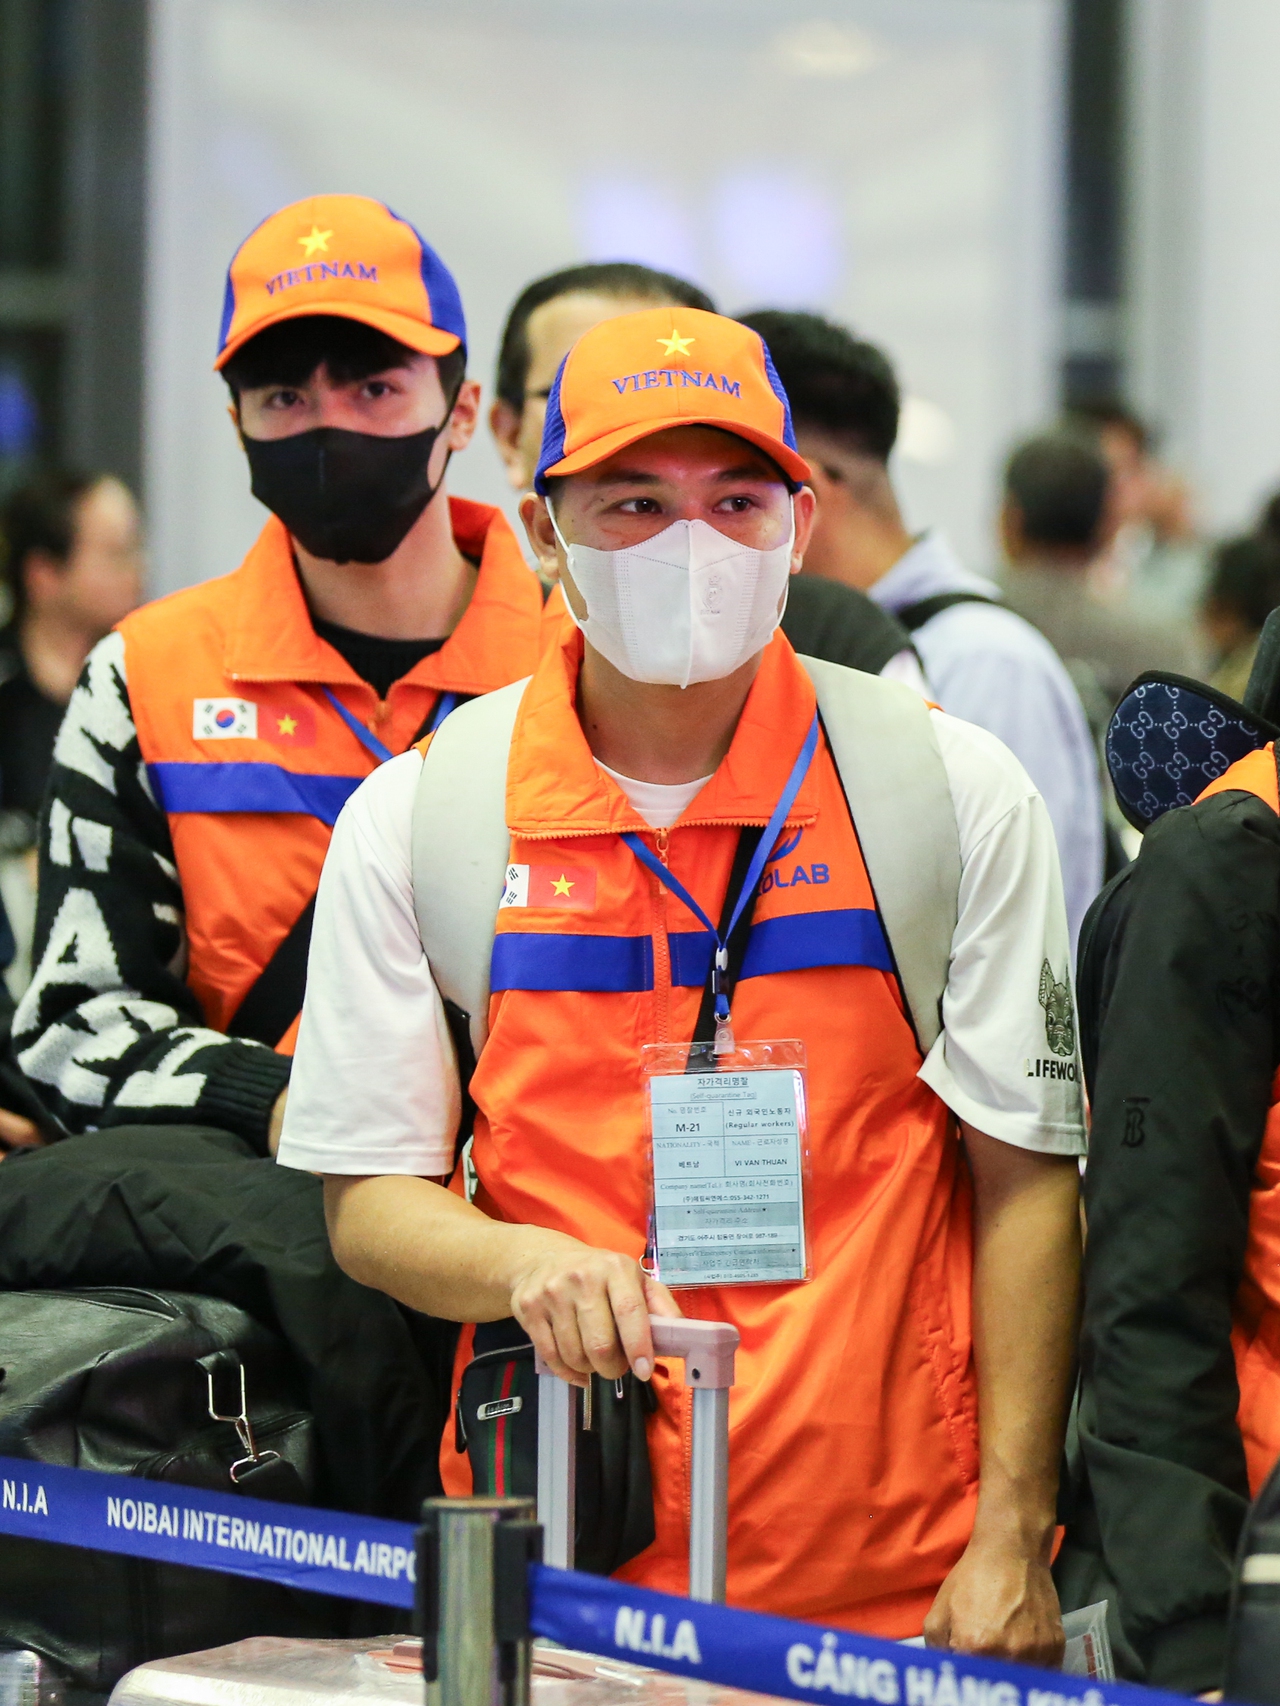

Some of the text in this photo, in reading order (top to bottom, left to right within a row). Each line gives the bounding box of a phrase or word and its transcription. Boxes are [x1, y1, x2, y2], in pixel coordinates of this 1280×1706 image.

[265, 260, 380, 297] VIETNAM
[611, 369, 742, 399] VIETNAM
[758, 863, 830, 896] OLAB
[697, 1076, 749, 1087] 자가격리명찰
[727, 1107, 792, 1117] 신규 외국인노동자
[675, 1123, 701, 1133] M-21
[725, 1120, 795, 1130] (Regular workers)
[731, 1139, 752, 1147] NAME
[678, 1160, 700, 1169] 베트남
[762, 1158, 788, 1166] THUAN
[3, 1479, 49, 1516] N.I.A
[107, 1497, 179, 1539] NOIBAI
[183, 1508, 351, 1571] INTERNATIONAL
[615, 1605, 702, 1665] N.I.A
